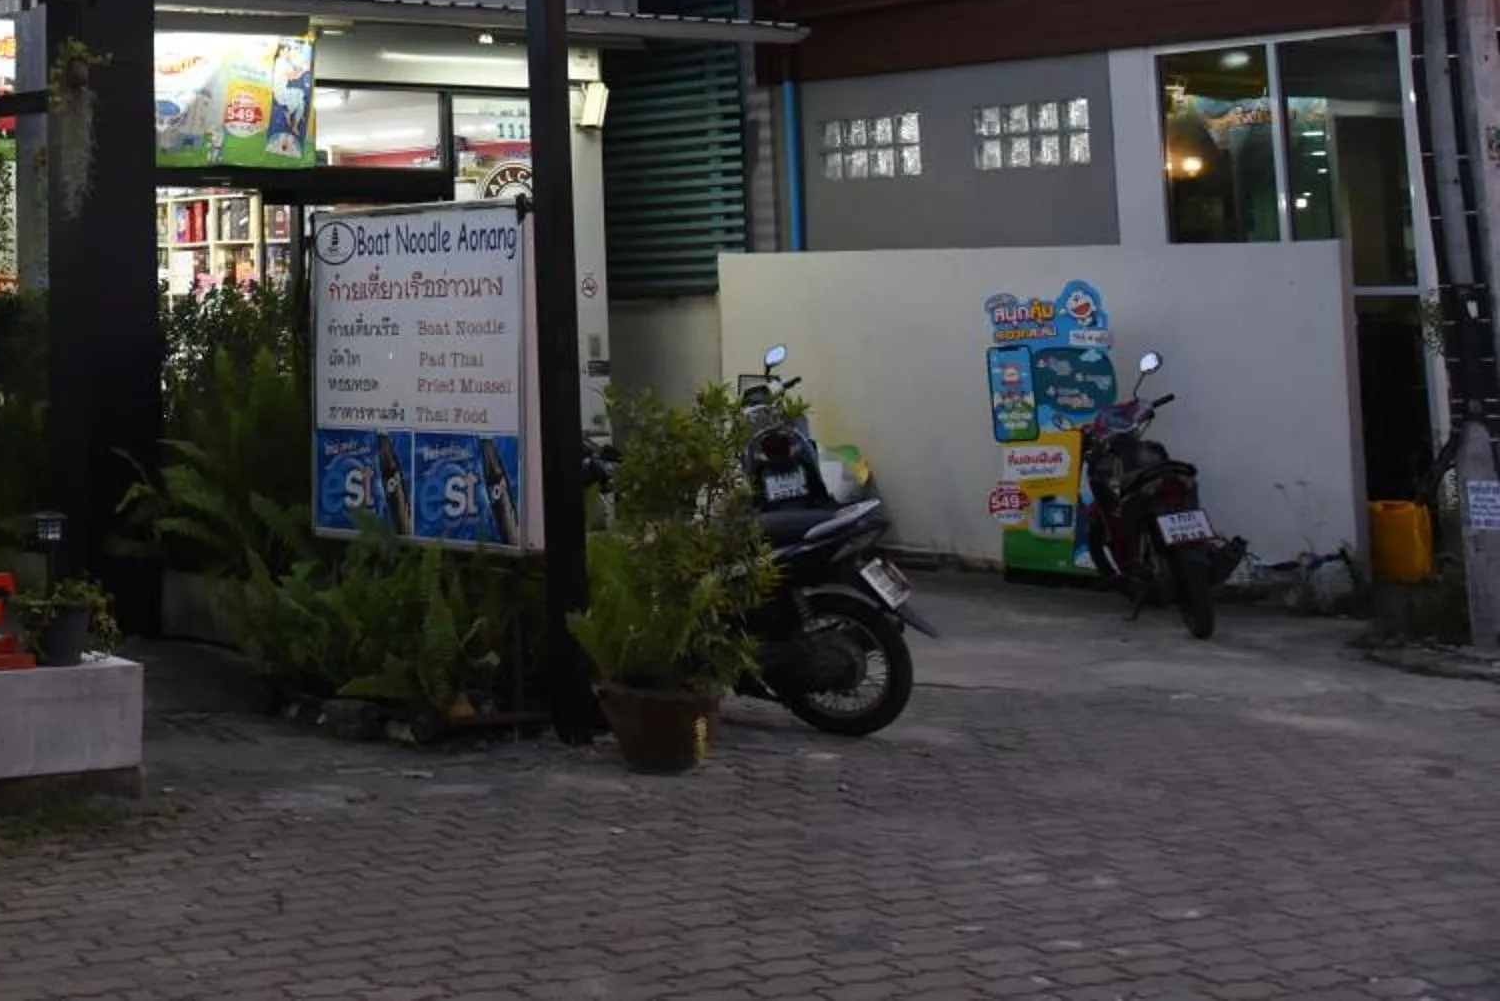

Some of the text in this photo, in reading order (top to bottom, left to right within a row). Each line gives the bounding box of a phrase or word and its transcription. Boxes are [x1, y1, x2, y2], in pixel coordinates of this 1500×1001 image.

[357, 221, 517, 260] Boat Noodle Aonang
[416, 318, 506, 336] Boat Noodle
[419, 351, 484, 368] Pad Thai
[417, 376, 513, 394] Fried Mussel
[415, 405, 488, 424] Thai Food
[419, 470, 479, 522] est
[990, 494, 1019, 509] 549
